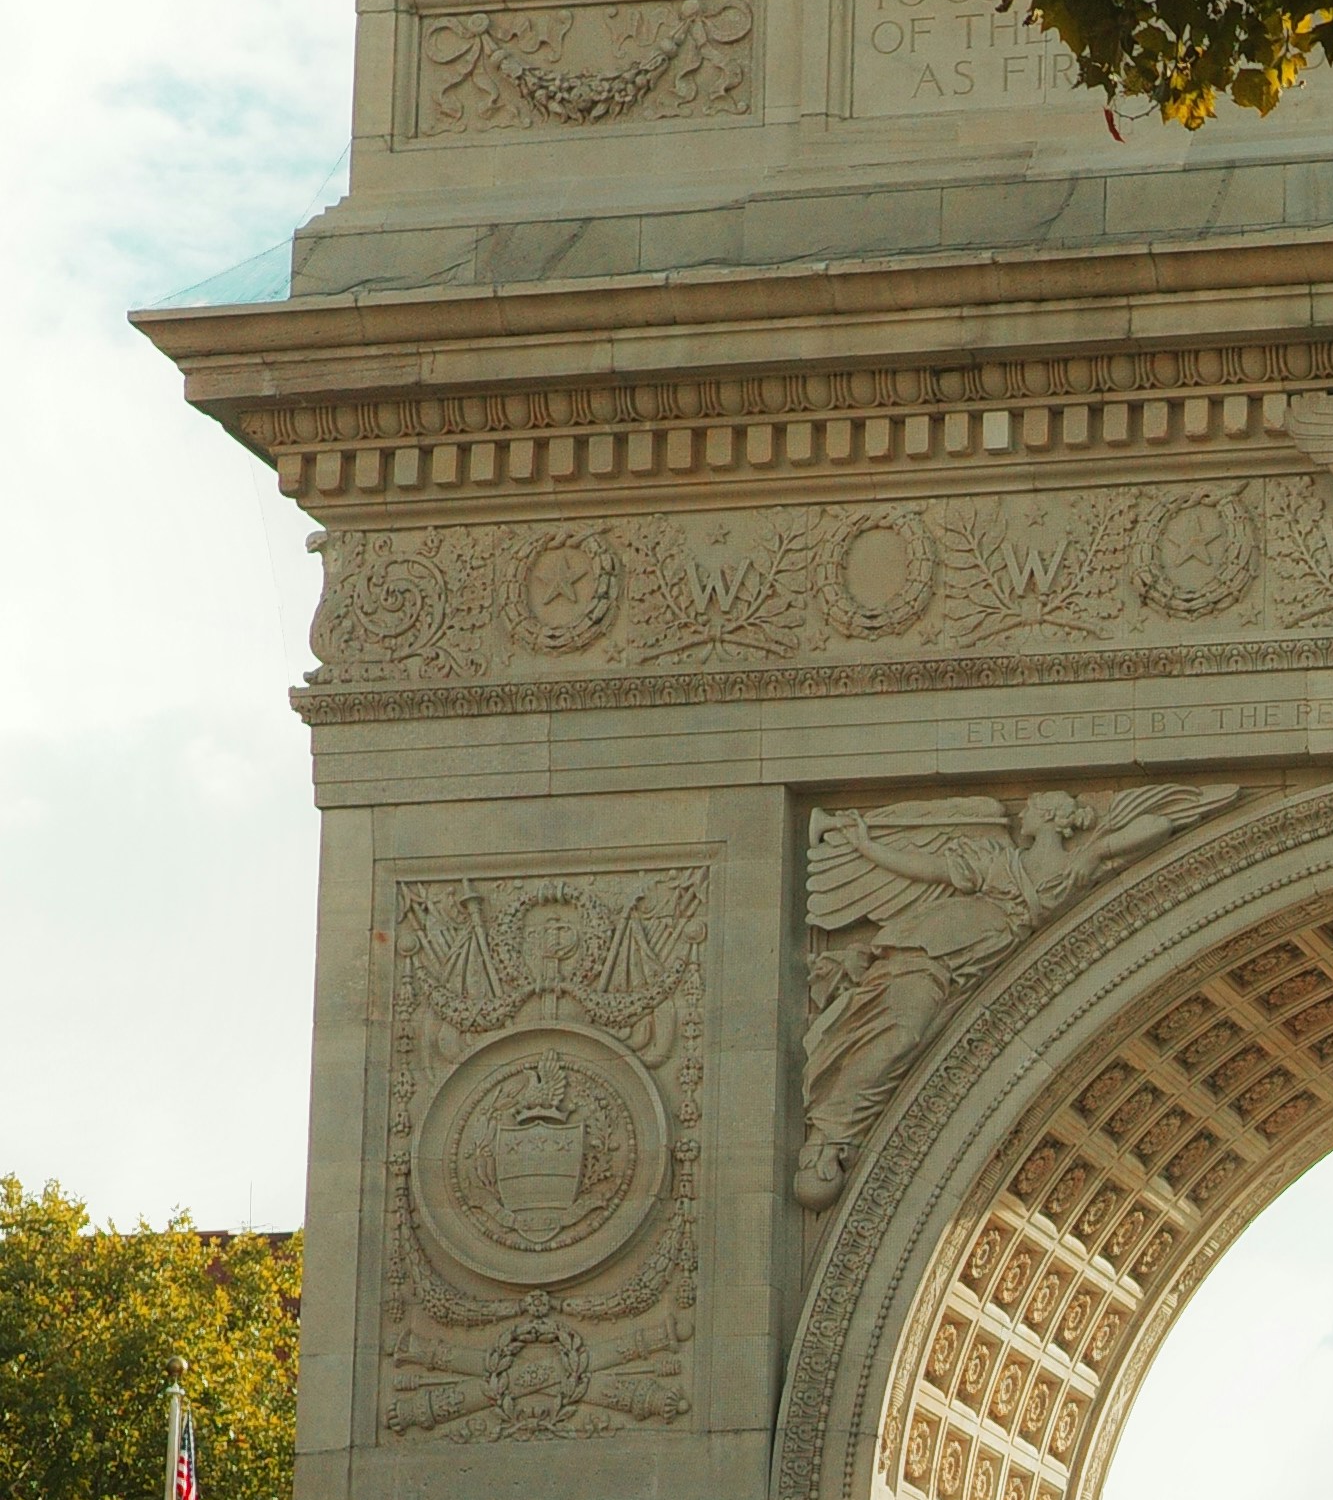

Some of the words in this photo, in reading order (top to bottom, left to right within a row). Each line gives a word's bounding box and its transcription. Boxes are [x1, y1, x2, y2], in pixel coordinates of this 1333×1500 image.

[871, 16, 936, 54] OF
[910, 60, 975, 99] AS
[1002, 53, 1078, 92] FIR
[967, 713, 1132, 743] ERECTED
[1152, 708, 1192, 733] BY
[1210, 702, 1280, 730] THE
